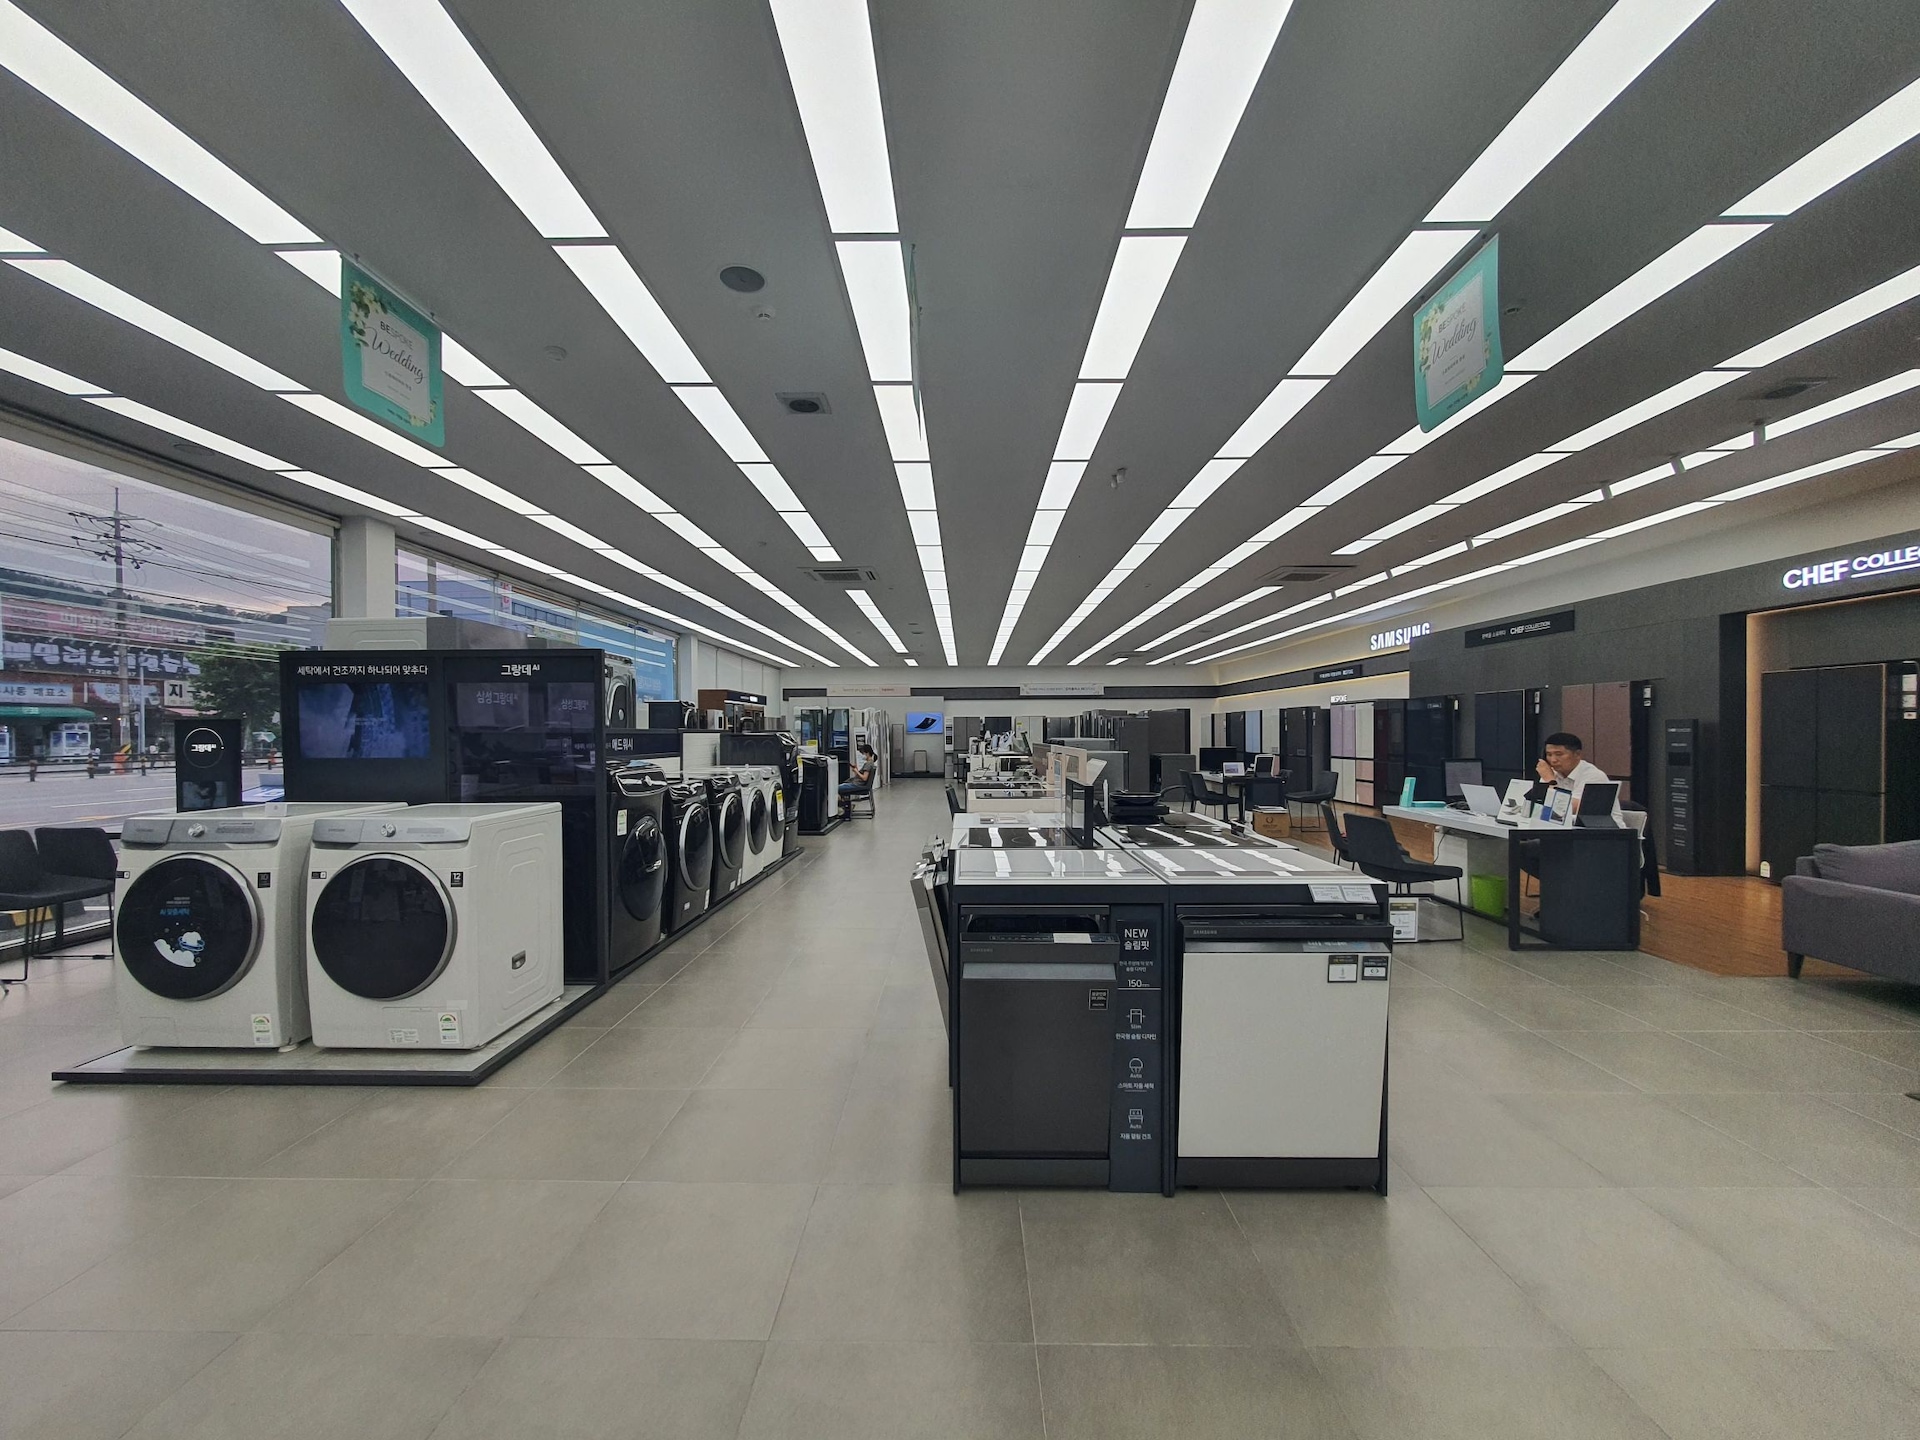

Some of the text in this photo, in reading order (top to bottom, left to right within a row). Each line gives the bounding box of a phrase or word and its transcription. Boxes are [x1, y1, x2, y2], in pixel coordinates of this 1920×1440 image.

[1438, 302, 1467, 333] BESPOKE
[380, 320, 413, 351] BESPOKE
[1432, 318, 1477, 364] Wedding
[364, 327, 425, 384] Wedding
[1782, 545, 1920, 589] CHEF COLLE
[1370, 622, 1430, 651] SAMSUNG
[1510, 625, 1525, 635] CHEF
[1525, 621, 1551, 630] COLLECTION
[297, 665, 428, 676] 세탁에서 건조까지 하나되어 맞추다
[453, 872, 462, 880] 12
[1124, 928, 1149, 939] NEW
[1124, 940, 1150, 952] 슬림핏
